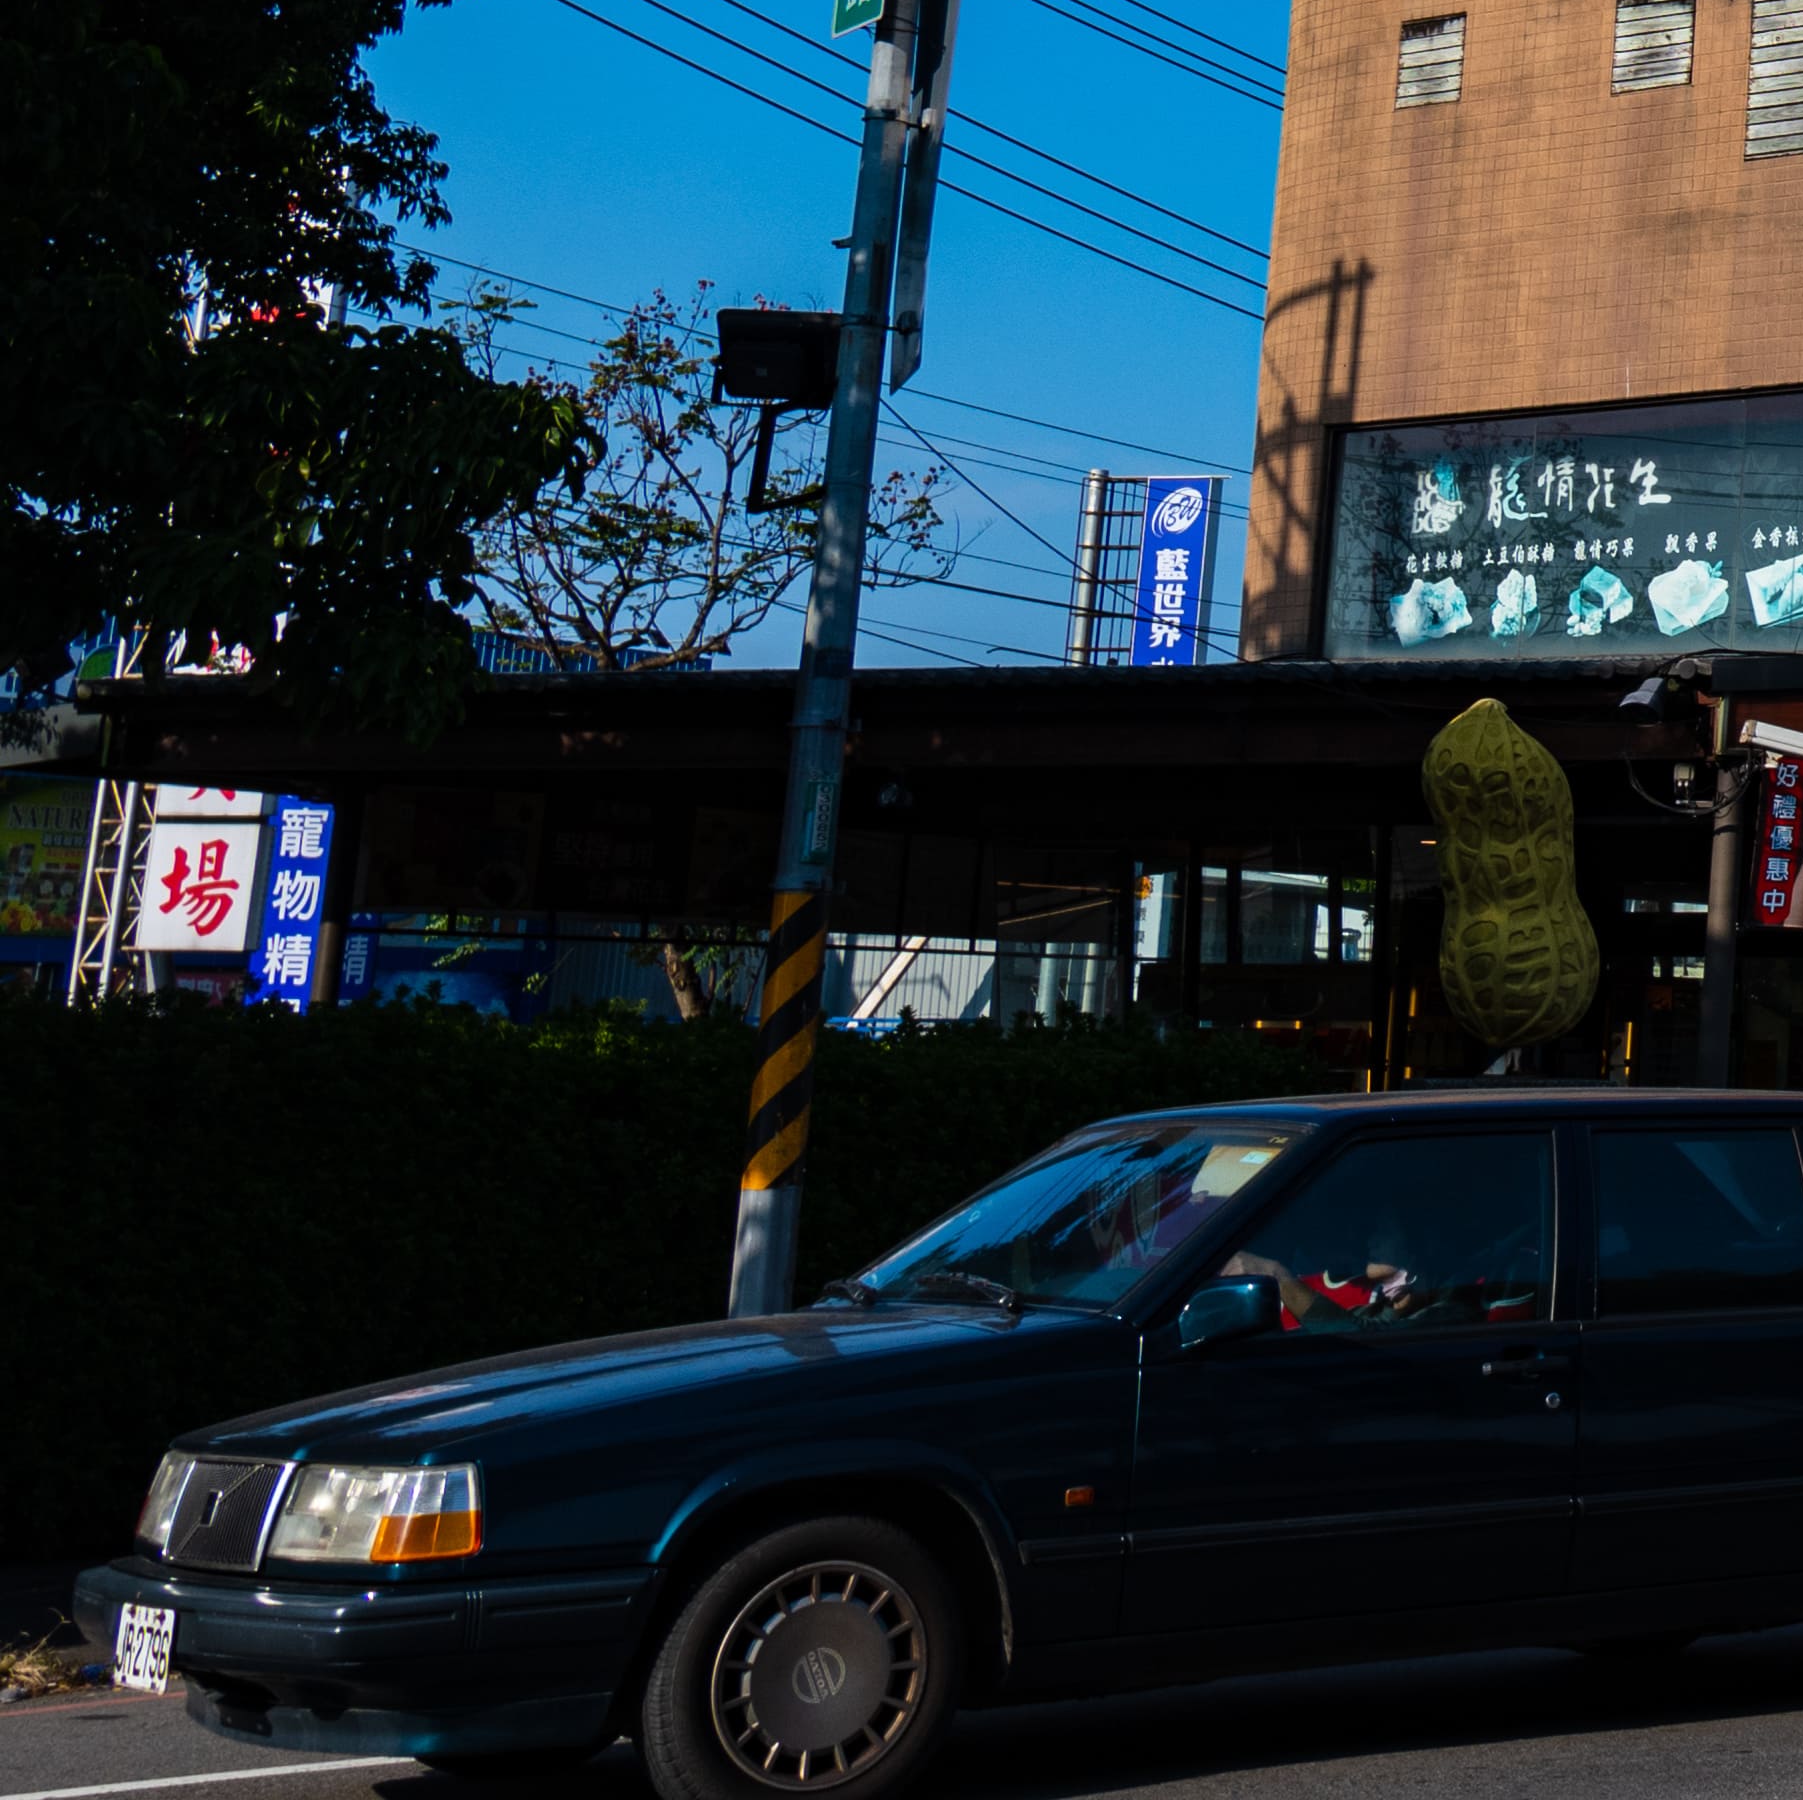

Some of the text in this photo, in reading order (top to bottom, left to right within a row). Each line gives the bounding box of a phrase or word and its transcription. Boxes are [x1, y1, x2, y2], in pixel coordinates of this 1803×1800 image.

[1762, 762, 1800, 914] 好禮優惠中
